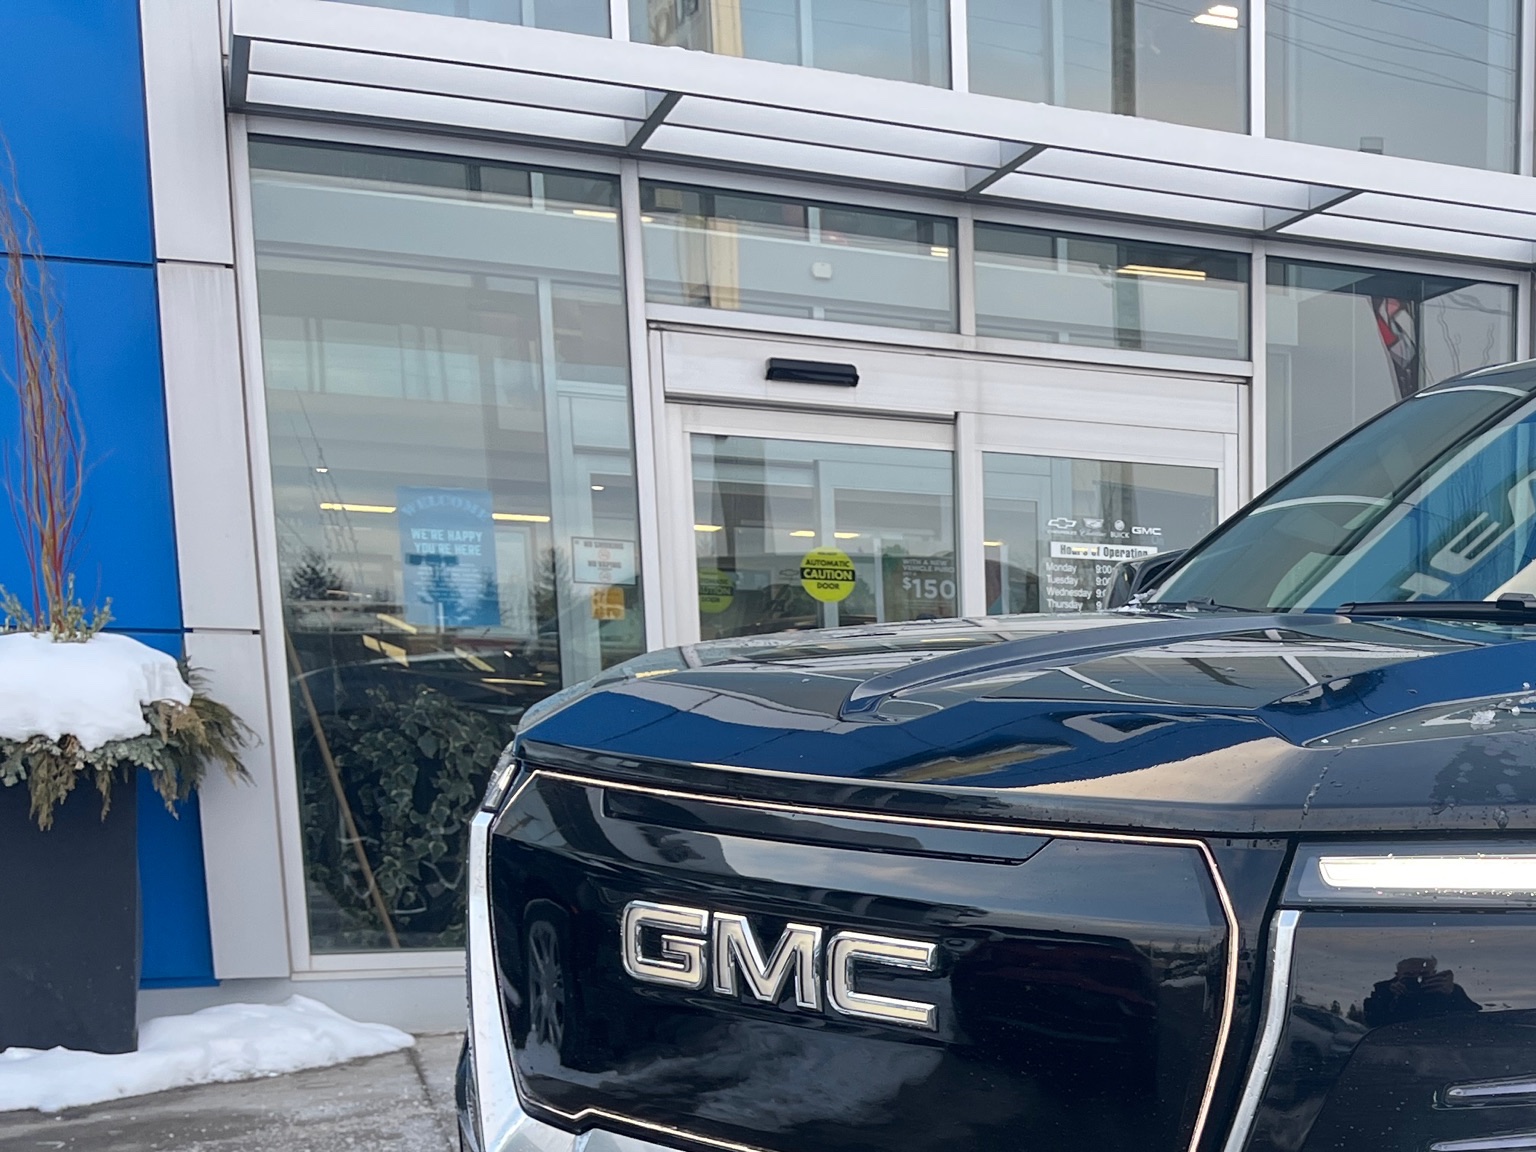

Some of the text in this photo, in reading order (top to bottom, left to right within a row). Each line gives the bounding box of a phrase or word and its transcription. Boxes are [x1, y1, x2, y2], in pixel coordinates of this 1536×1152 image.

[410, 528, 482, 542] WE'RE HAPPY
[1110, 531, 1130, 539] BUICK
[1131, 526, 1162, 536] GMC
[413, 542, 482, 556] YOU'RE HERE
[1103, 546, 1148, 559] Operation
[805, 559, 850, 568] AUTOMATIC
[1045, 562, 1112, 574] Monday 9:00
[803, 568, 852, 580] CAUTION
[816, 582, 840, 590] DOOR
[1046, 575, 1078, 586] Tuesday
[1046, 587, 1092, 599] Wednesday
[1046, 598, 1084, 612] Thursday
[620, 900, 939, 1032] GMC
